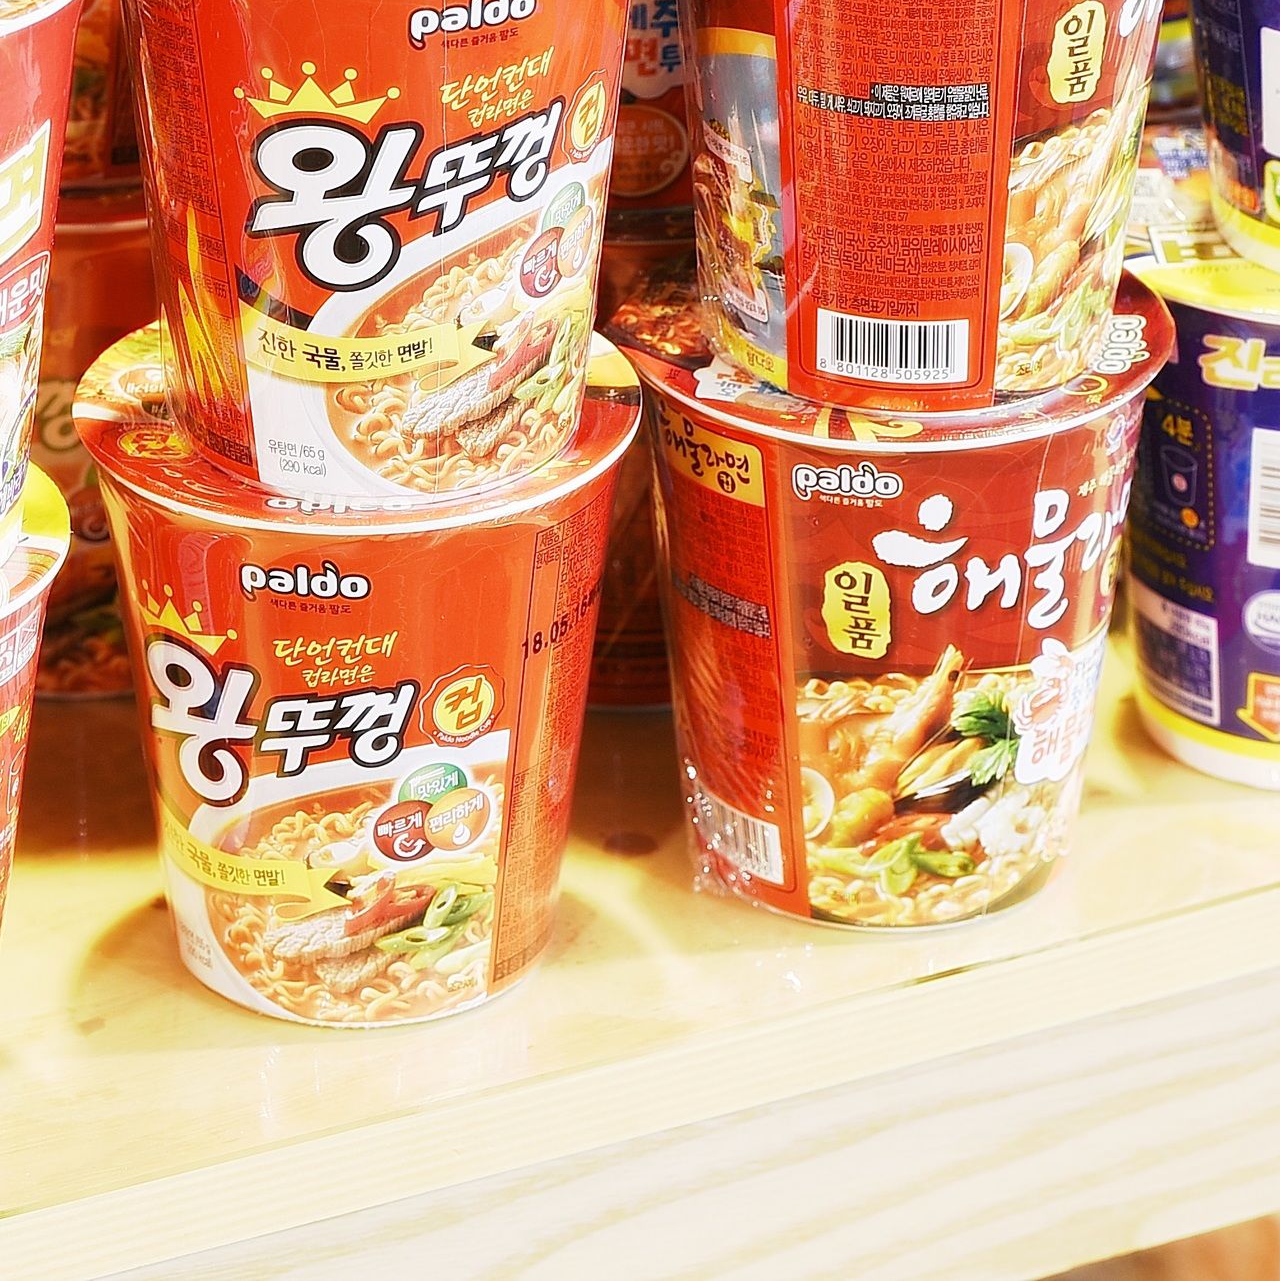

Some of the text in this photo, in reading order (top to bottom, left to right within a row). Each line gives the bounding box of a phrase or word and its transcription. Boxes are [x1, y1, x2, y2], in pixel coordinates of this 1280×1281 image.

[1062, 10, 1098, 96] 일품
[439, 45, 556, 112] 단언컨대
[468, 90, 535, 127] 컵라면은
[250, 103, 564, 286] 왕뚜껑
[257, 329, 297, 360] 진한
[348, 348, 393, 369] 쫄깃한
[397, 337, 433, 361] 면발!
[895, 369, 949, 380] 505925
[793, 463, 904, 500] paldo
[240, 561, 371, 602] paldo
[832, 569, 882, 649] 일품
[272, 629, 399, 668] 단언컨대
[302, 667, 376, 687] 컵라면은
[147, 637, 415, 803] 왕뚜껑
[444, 675, 490, 733] 컵
[377, 811, 423, 839] 빠르게
